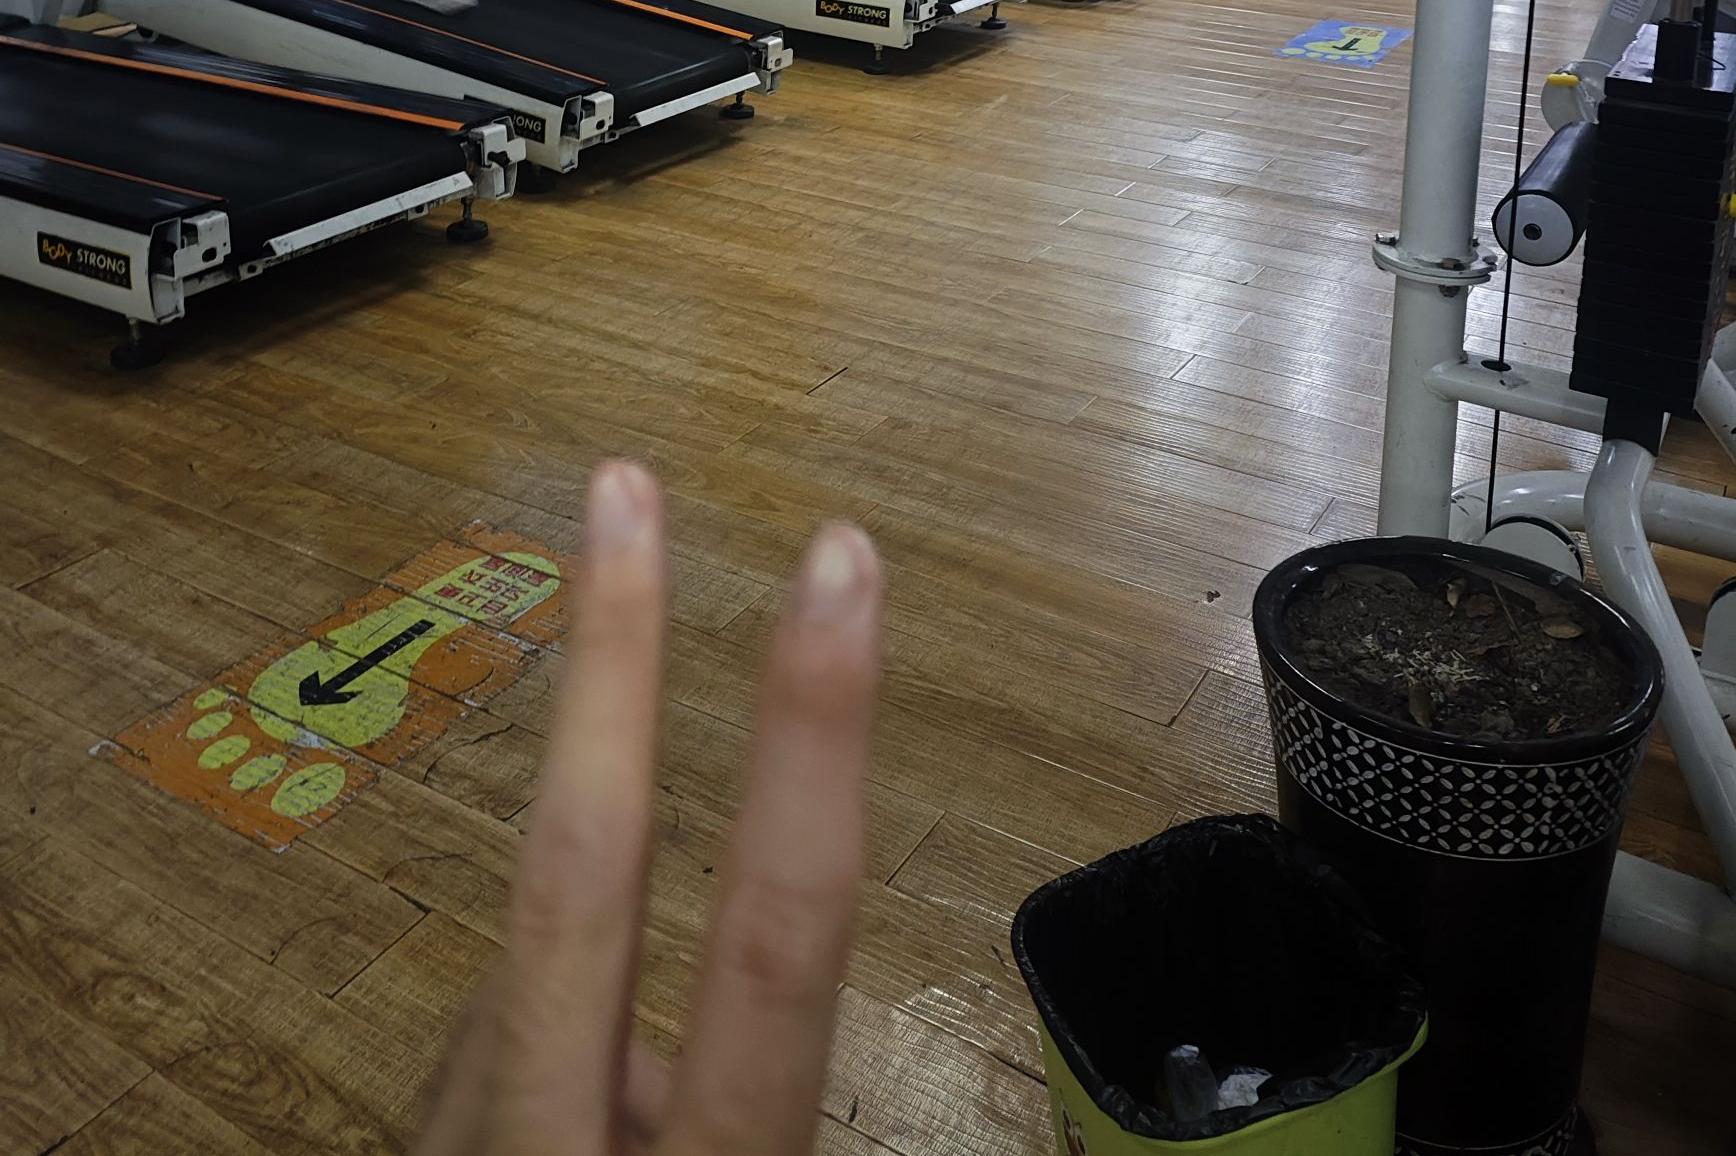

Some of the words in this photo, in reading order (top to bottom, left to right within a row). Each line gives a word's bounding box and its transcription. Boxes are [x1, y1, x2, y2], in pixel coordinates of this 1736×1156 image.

[820, 1, 845, 15] BODY
[847, 5, 887, 20] STRONG
[42, 238, 73, 264] BODY
[77, 248, 126, 275] STRONG
